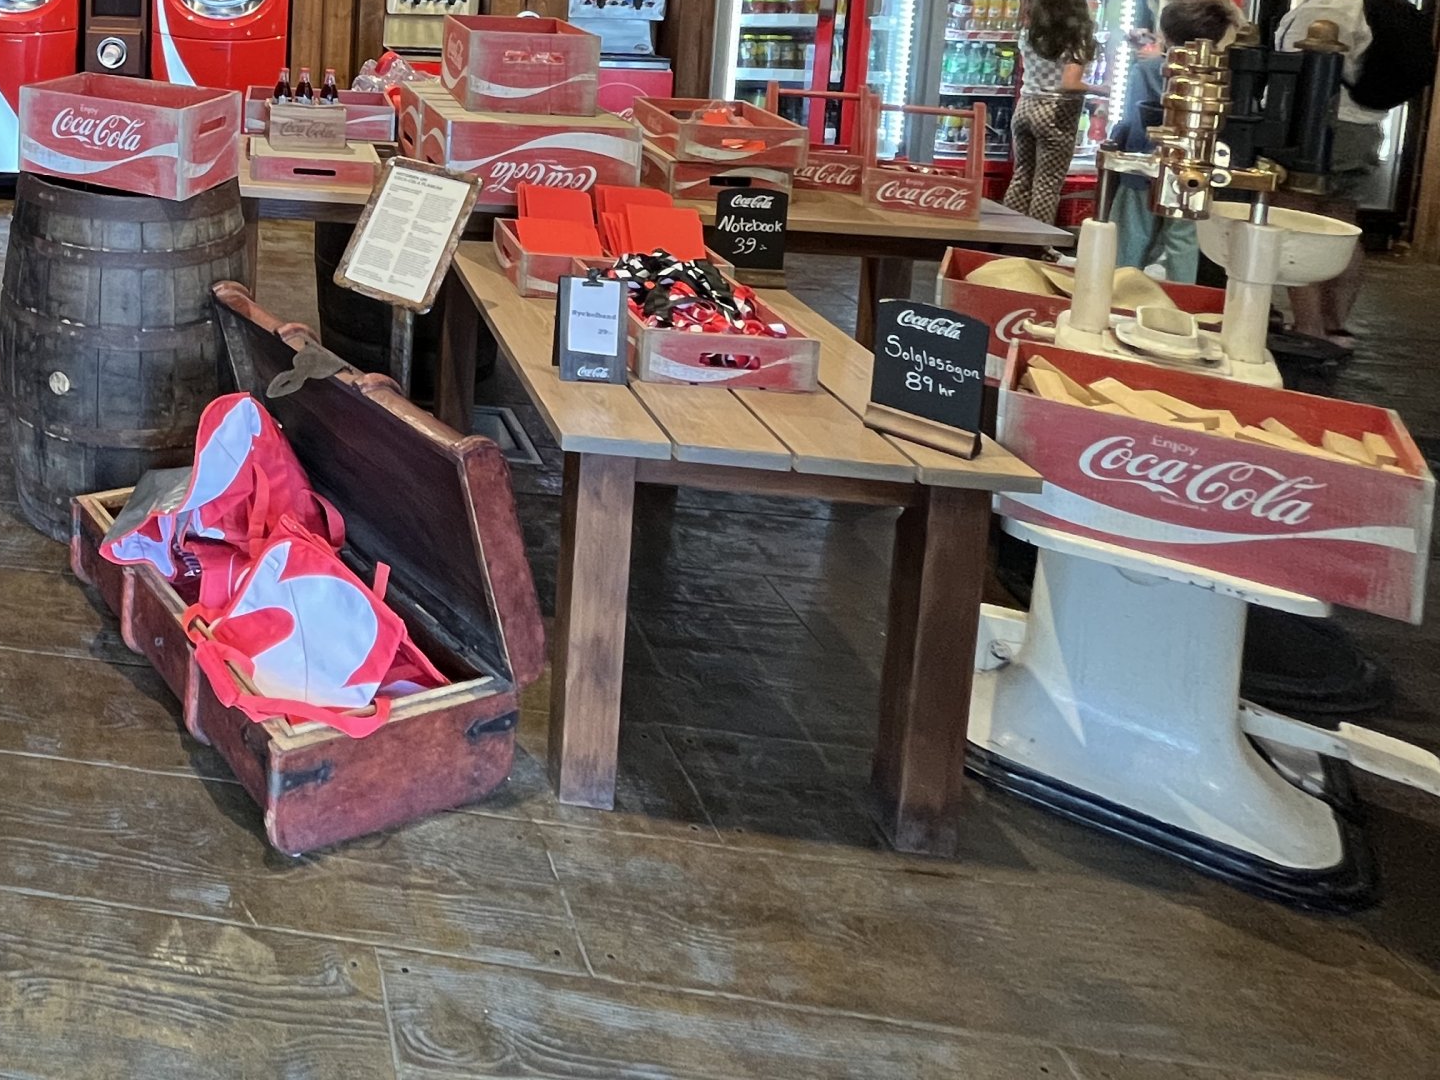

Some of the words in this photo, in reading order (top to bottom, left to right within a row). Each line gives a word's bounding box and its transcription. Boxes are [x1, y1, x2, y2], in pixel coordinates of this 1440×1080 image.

[51, 107, 146, 152] Coca-Cola
[281, 120, 337, 139] Coca-Cola
[485, 161, 597, 194] Coca-Cola
[730, 194, 775, 209] Coca-Cola
[876, 181, 973, 212] Coca-Cola
[718, 215, 783, 233] Notebook
[896, 309, 965, 340] Coca-Cola
[577, 366, 610, 378] Coca-Cola
[884, 335, 981, 383] Solglasögon
[905, 372, 933, 392] 89
[1150, 434, 1199, 457] Enjoy
[1078, 435, 1327, 525] Coca-Cola
